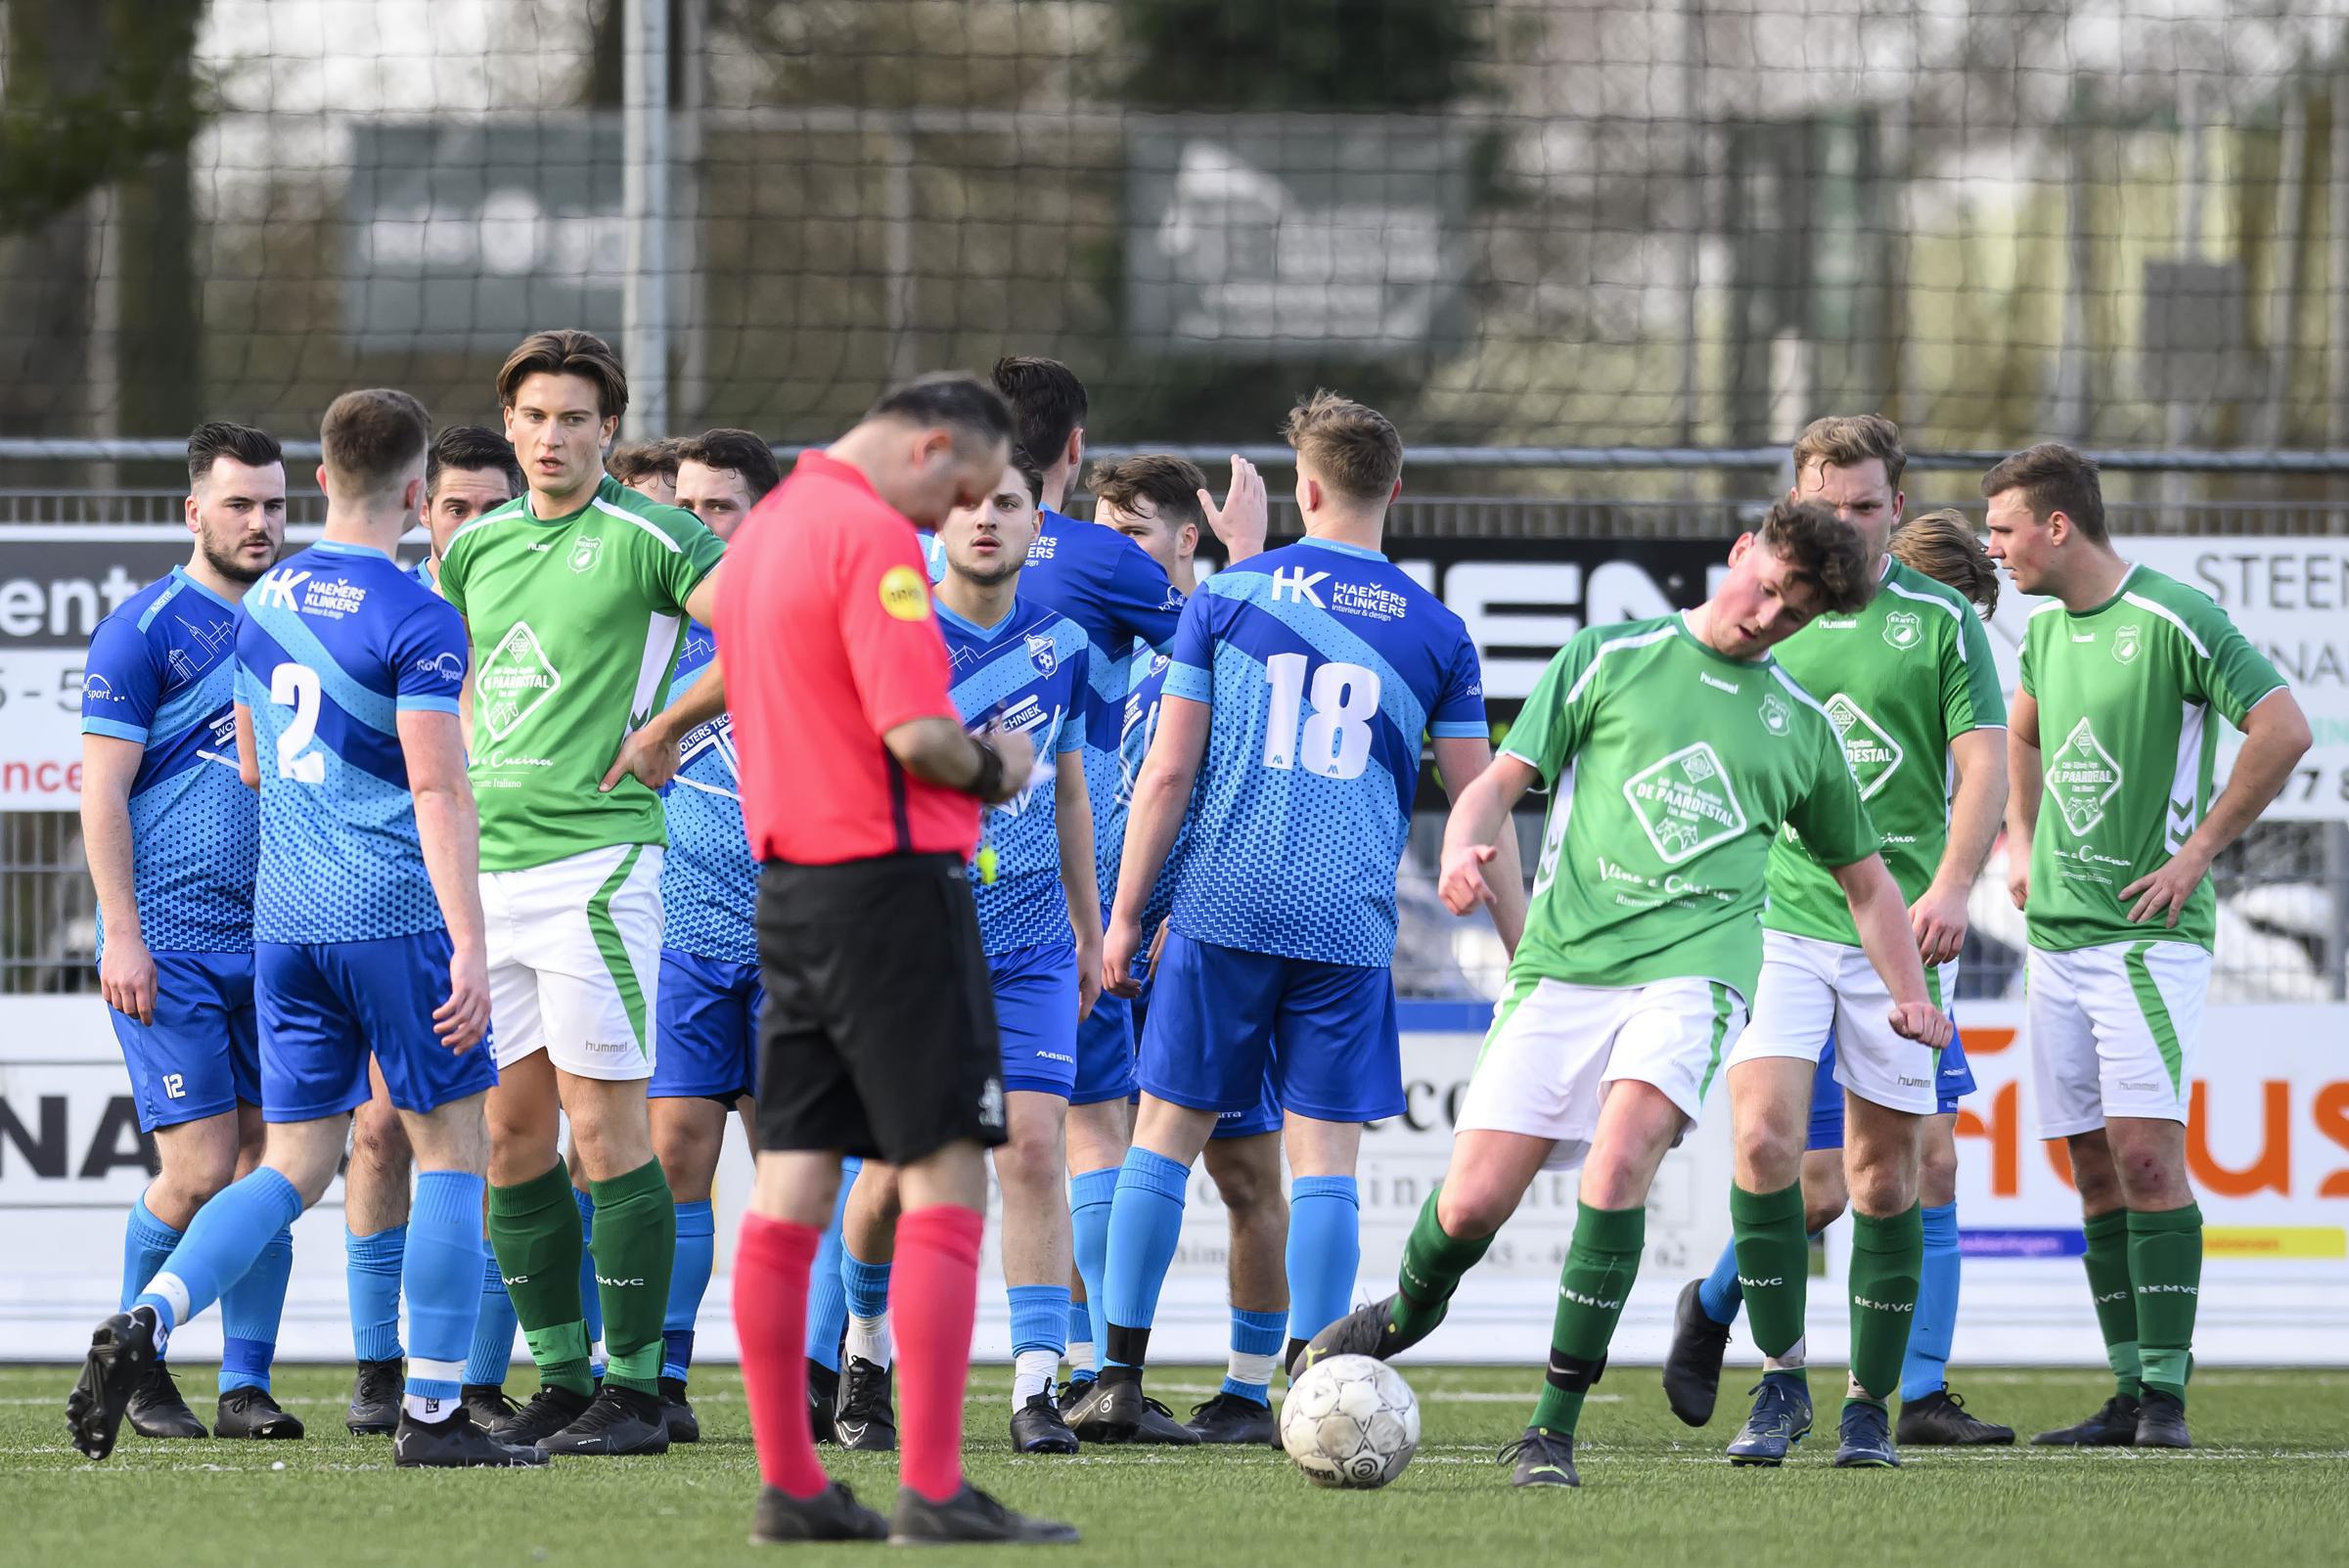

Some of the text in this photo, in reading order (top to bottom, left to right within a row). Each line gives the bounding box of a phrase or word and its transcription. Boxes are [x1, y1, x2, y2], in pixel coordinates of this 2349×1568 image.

[257, 568, 312, 611] HK
[1272, 565, 1331, 608] HK
[1333, 581, 1407, 607] HAEMERS
[2195, 554, 2349, 609] STEE
[304, 593, 360, 613] KLINKERS
[1333, 593, 1406, 618] KLINKERS
[1818, 619, 1857, 629] hummel
[1699, 672, 1739, 694] hummel
[271, 662, 326, 784] 2
[1263, 651, 1381, 780] 18
[679, 725, 711, 752] OLTERS
[1636, 782, 1658, 798] DE
[1656, 787, 1735, 829] PAARDESTAL
[585, 1040, 627, 1053] hummel
[162, 1073, 186, 1099] 12
[2119, 1079, 2160, 1093] hummel
[2138, 1283, 2198, 1296] RKMVC
[1854, 1294, 1914, 1313] RKMVC
